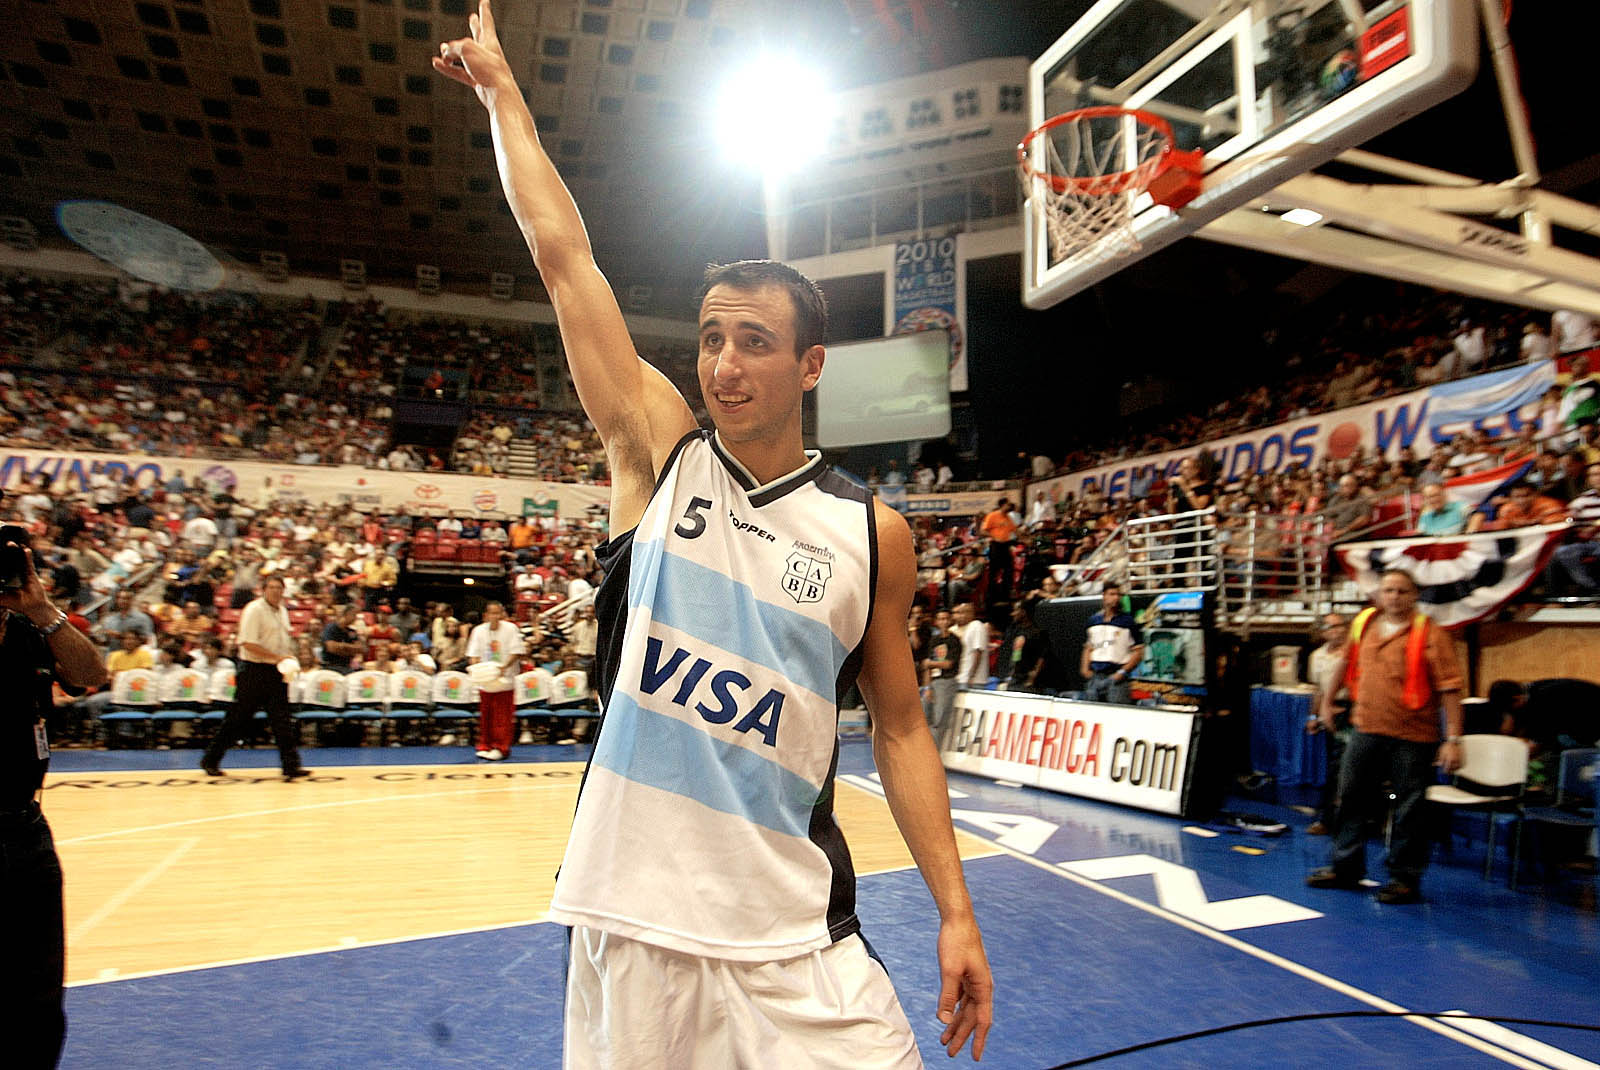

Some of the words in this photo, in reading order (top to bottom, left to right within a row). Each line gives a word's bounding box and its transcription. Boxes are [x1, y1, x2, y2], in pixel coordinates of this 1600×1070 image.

[896, 237, 954, 265] 2010
[674, 495, 712, 539] 5
[728, 509, 776, 542] TOPPER
[639, 635, 786, 748] VISA
[373, 770, 587, 782] Cleme
